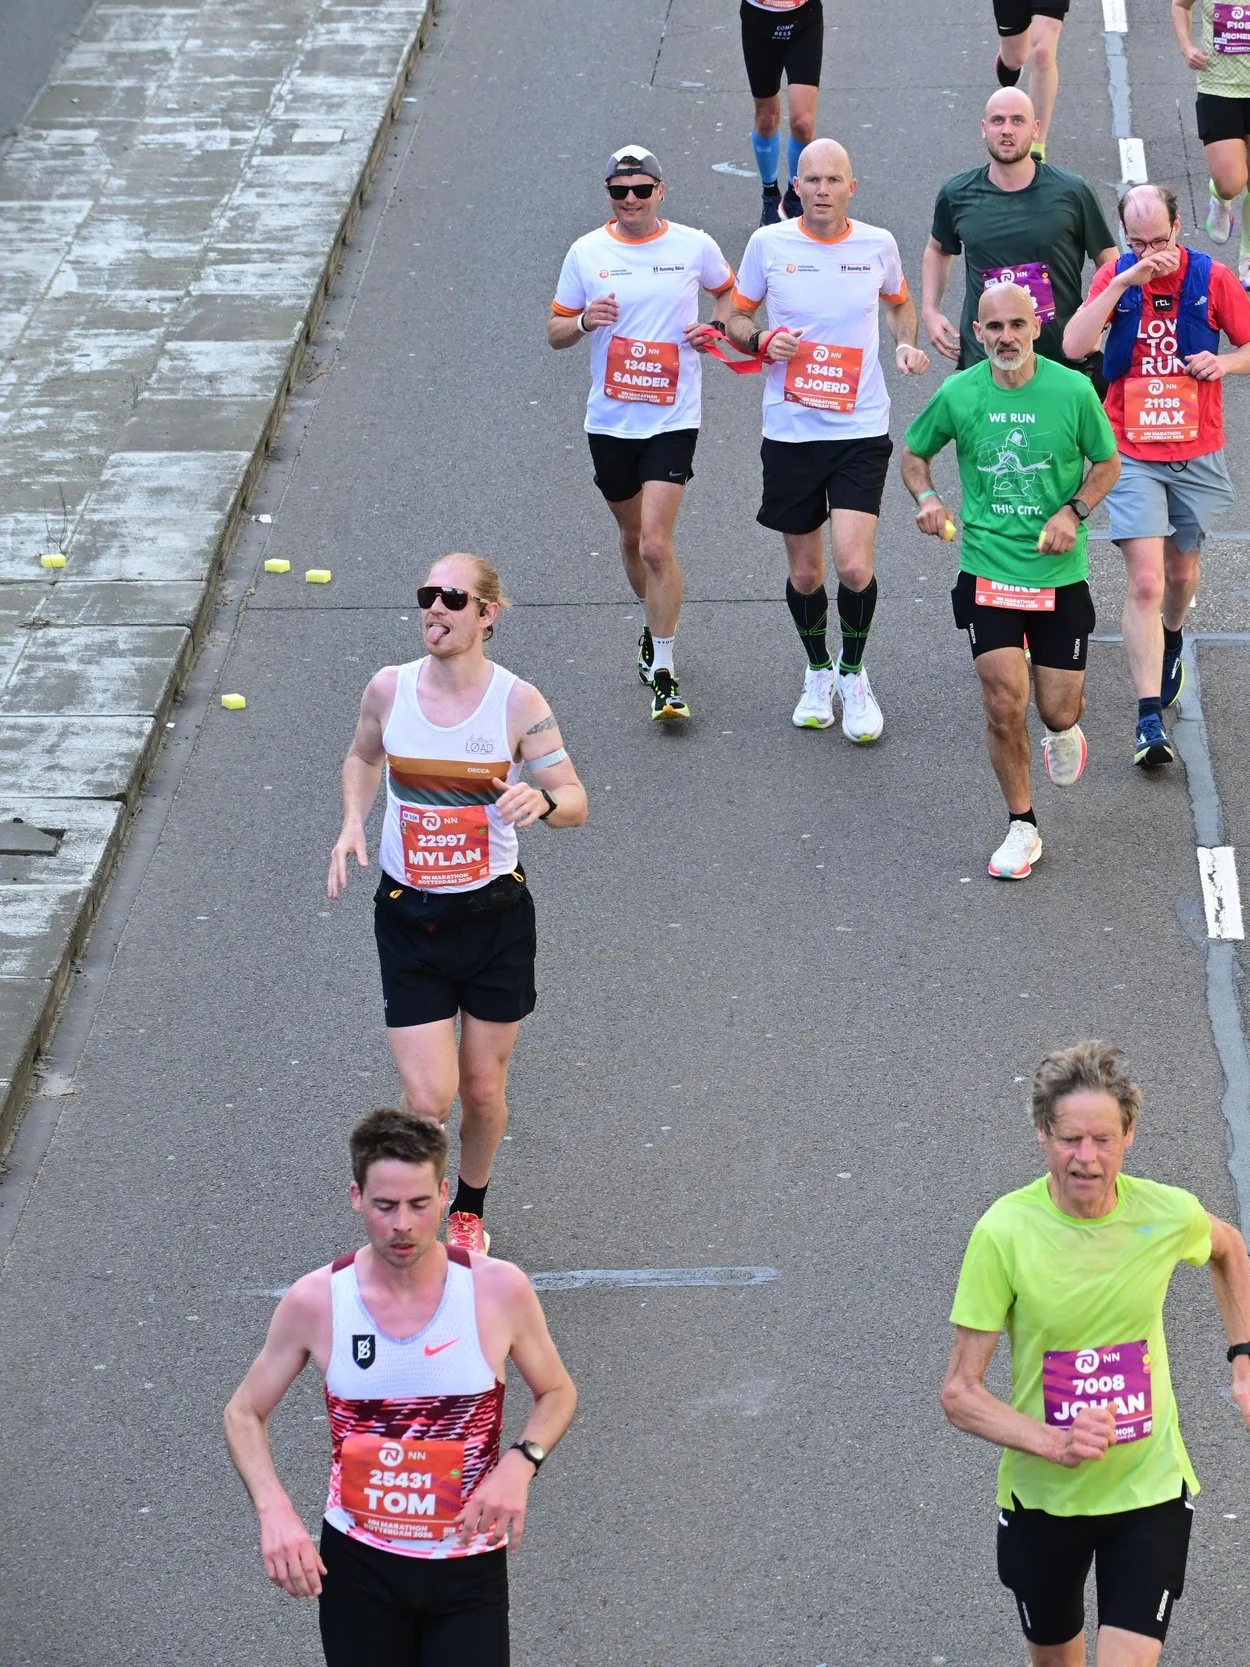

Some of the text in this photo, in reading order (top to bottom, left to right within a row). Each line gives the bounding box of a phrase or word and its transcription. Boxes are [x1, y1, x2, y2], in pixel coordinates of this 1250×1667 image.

[1137, 318, 1177, 338] LOV
[1147, 336, 1178, 356] TO
[624, 360, 662, 373] 13452
[806, 364, 843, 377] 13453
[1142, 355, 1187, 375] RUN
[613, 371, 670, 388] SANDER
[794, 376, 850, 394] SJOERD
[1144, 397, 1180, 408] 21136
[989, 412, 1036, 424] WE RUN
[1140, 410, 1186, 426] MAX
[991, 504, 1043, 515] THIS CITY.
[1073, 638, 1081, 660] FUSION
[417, 834, 467, 847] 22997
[408, 847, 482, 866] MYLAN
[1103, 1352, 1120, 1363] NN
[1072, 1374, 1125, 1396] 7008
[408, 1451, 426, 1460] NN
[369, 1469, 432, 1489] 25431
[363, 1487, 436, 1516] TOM
[380, 1521, 428, 1532] MARATHON
